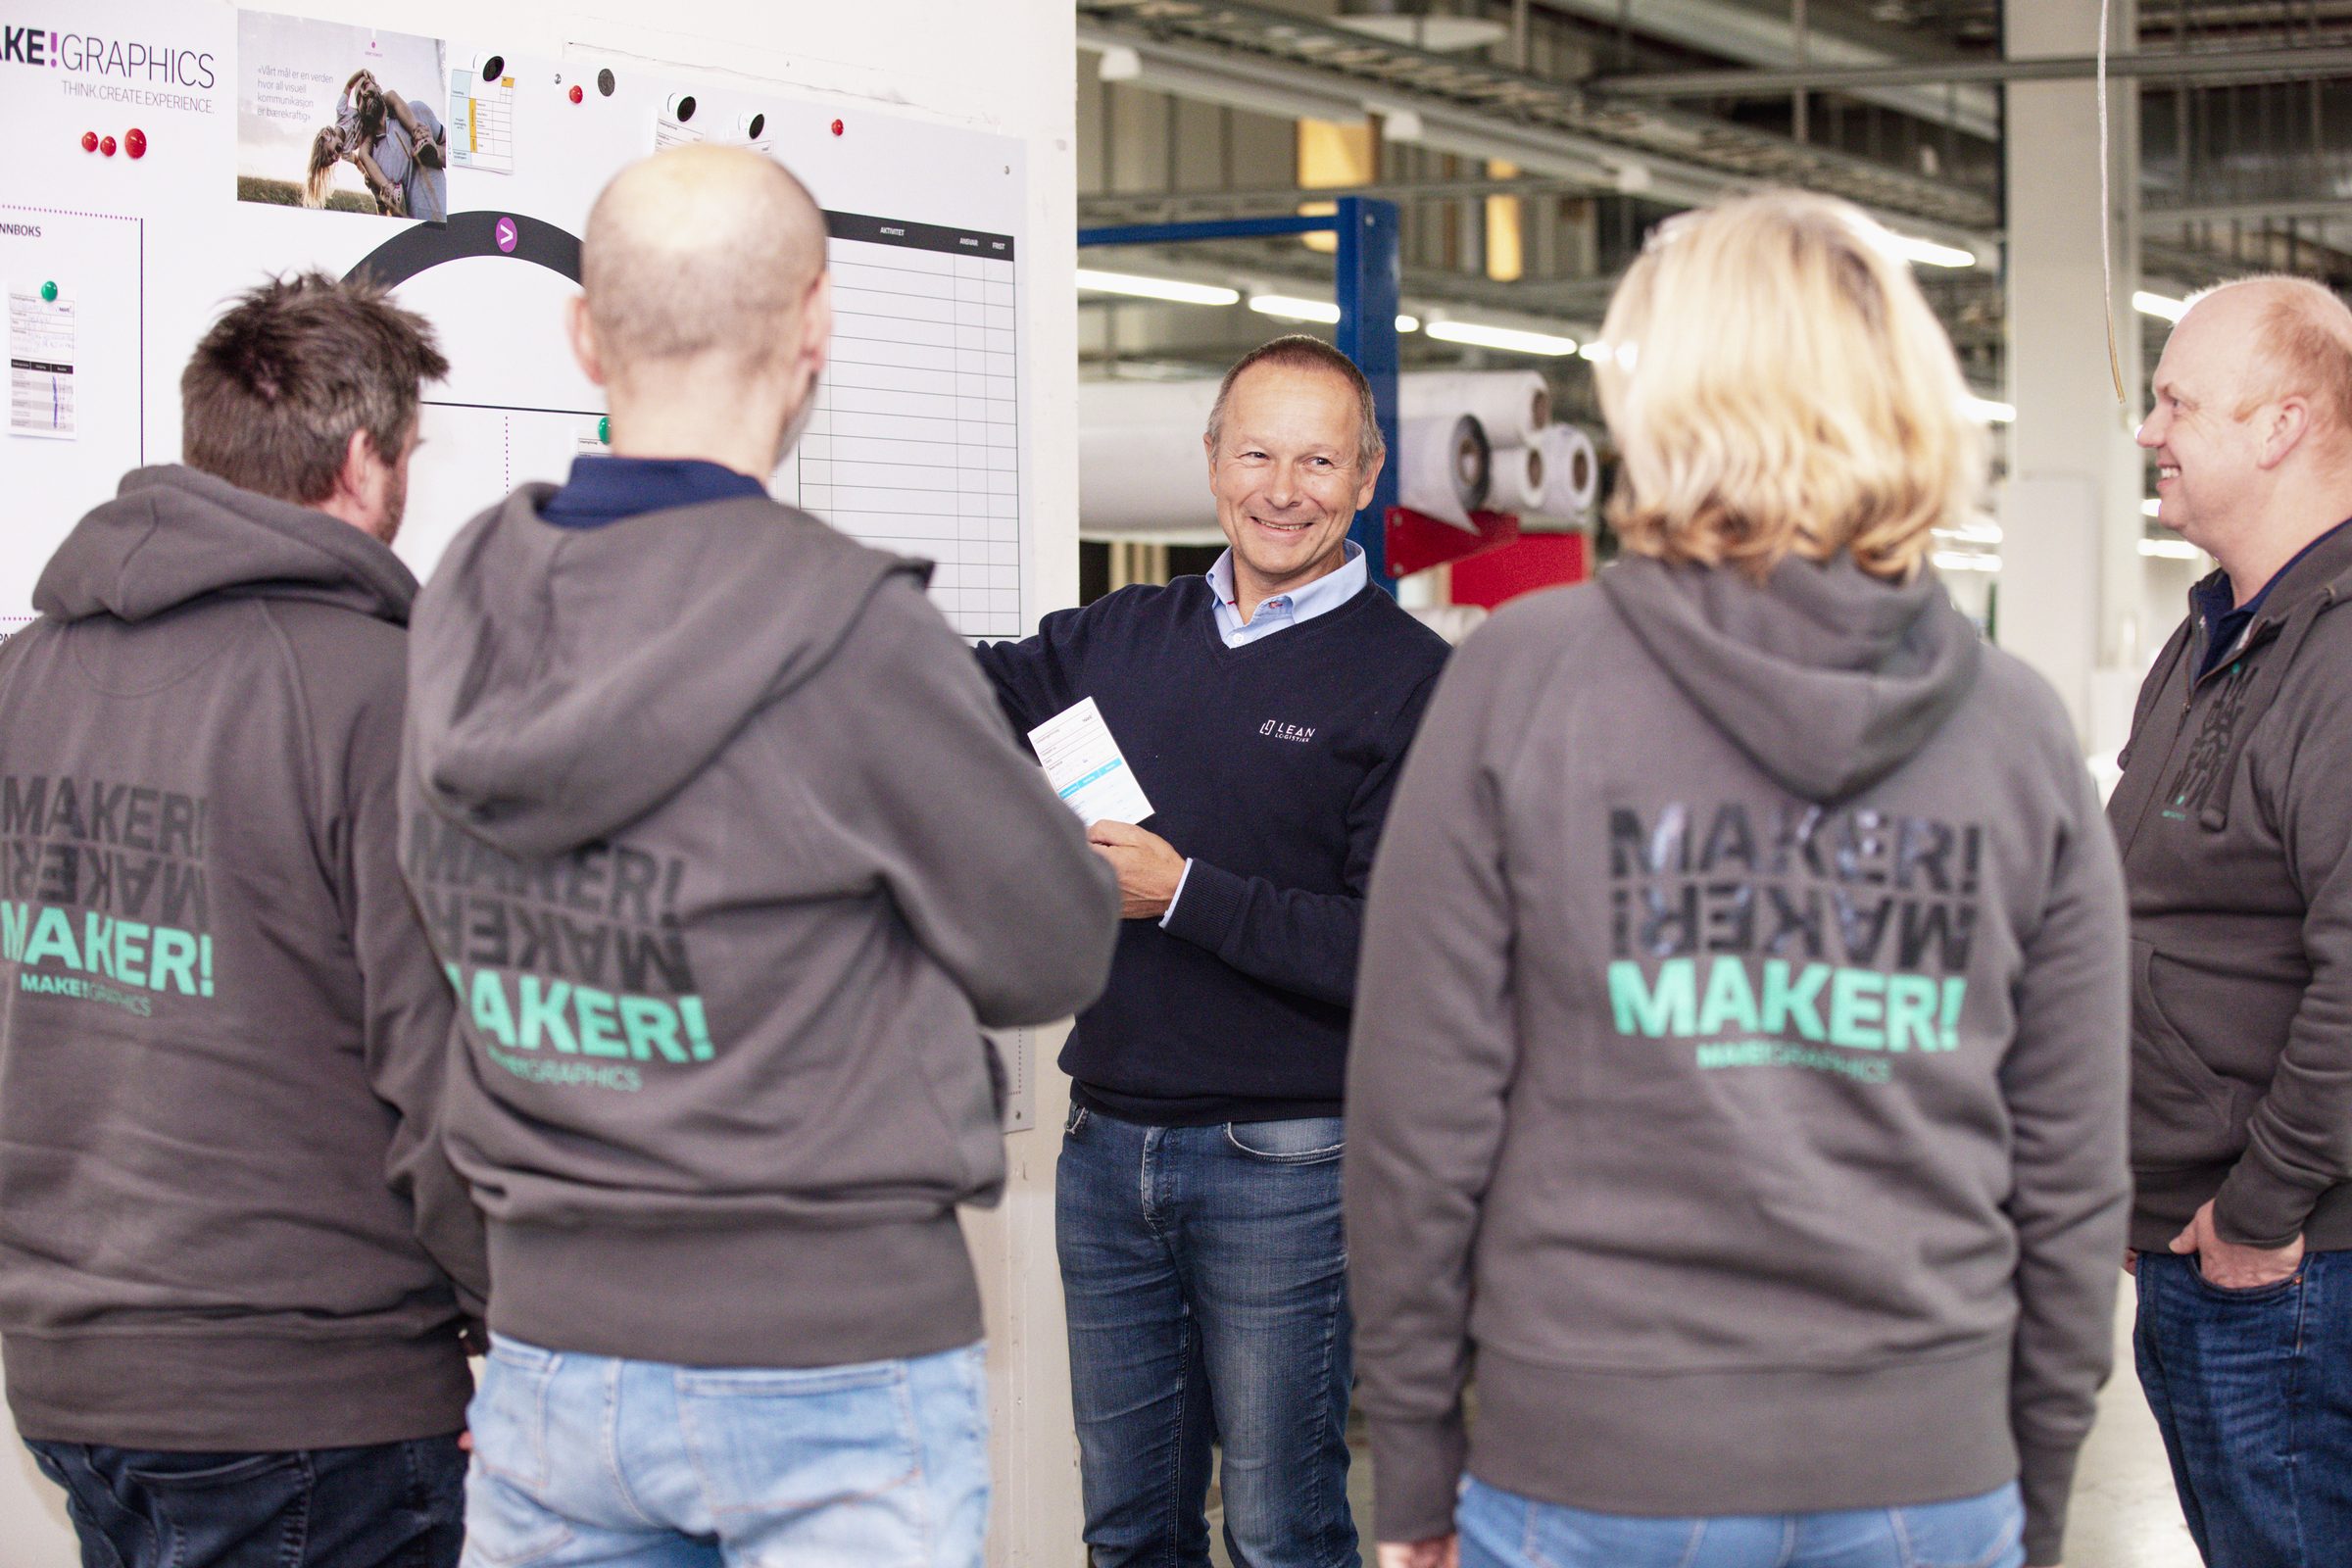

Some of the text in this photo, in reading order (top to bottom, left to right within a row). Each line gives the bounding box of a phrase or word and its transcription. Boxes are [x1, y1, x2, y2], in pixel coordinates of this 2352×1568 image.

[0, 25, 215, 89] KE!GRAPHICS
[277, 68, 291, 78] mål
[292, 71, 299, 79] er
[301, 72, 310, 80] en
[311, 74, 334, 83] verden
[258, 78, 274, 90] hvor
[284, 83, 307, 93] visuell
[257, 92, 314, 109] kommunikasjon
[257, 108, 265, 117] er
[1275, 732, 1310, 743] LOGISTIKK
[1278, 722, 1316, 738] LEAN
[1608, 802, 1983, 895] MAKER!
[1, 900, 215, 998] MAKER!
[1606, 955, 1969, 1054] MAKER!
